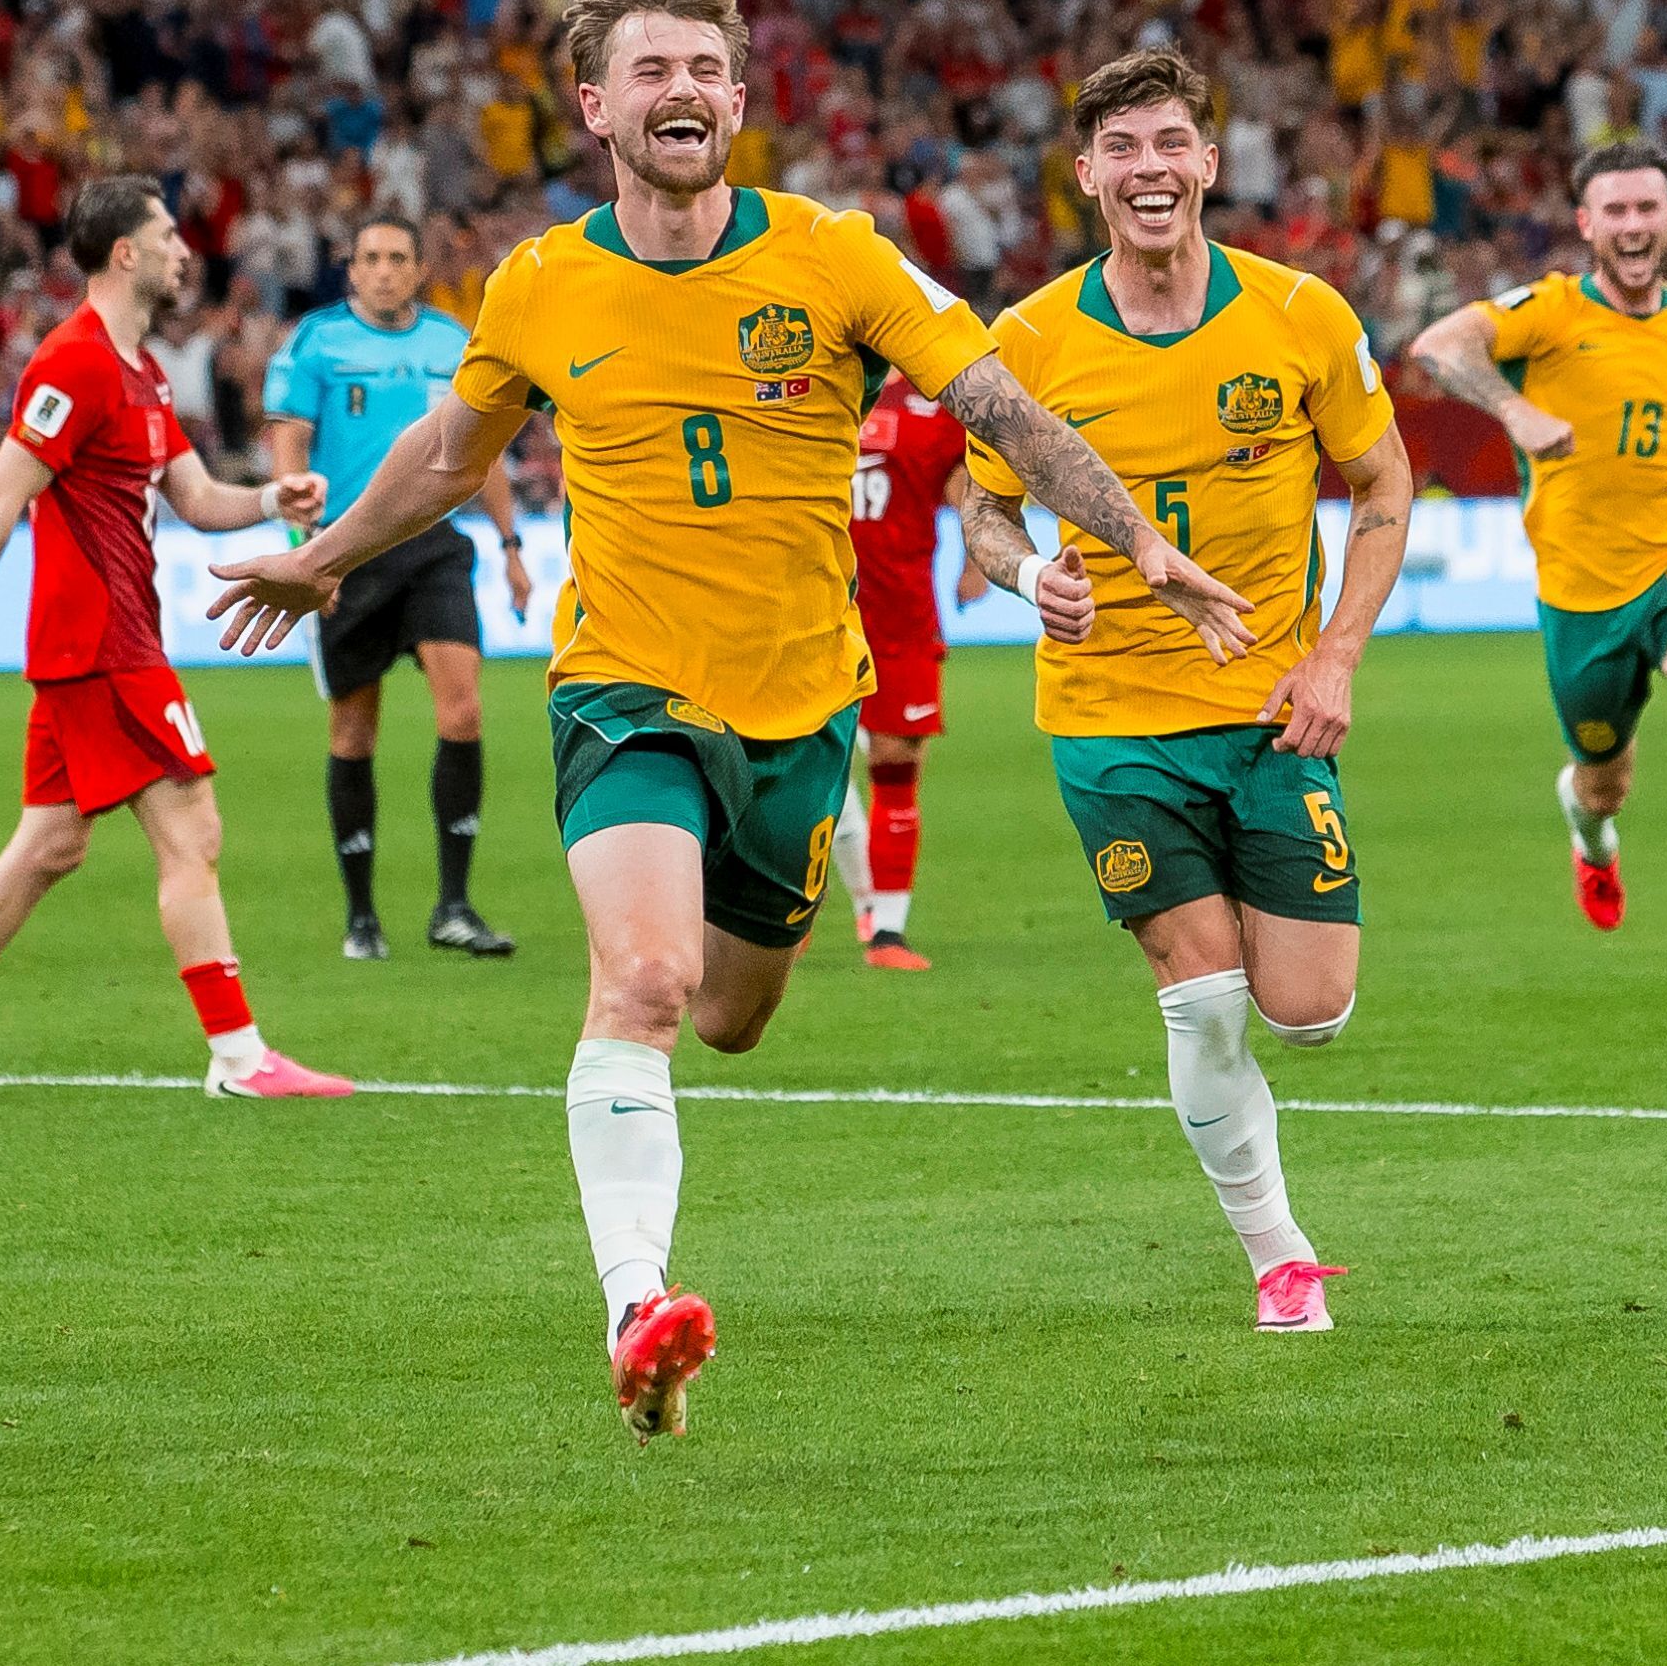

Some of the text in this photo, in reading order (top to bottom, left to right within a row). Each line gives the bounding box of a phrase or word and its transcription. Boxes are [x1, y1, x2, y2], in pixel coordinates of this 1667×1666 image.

[682, 413, 732, 508] 8
[1617, 400, 1663, 458] 13
[851, 469, 892, 522] 19
[1155, 480, 1191, 558] 5
[805, 815, 834, 902] 8
[1303, 791, 1349, 871] 5
